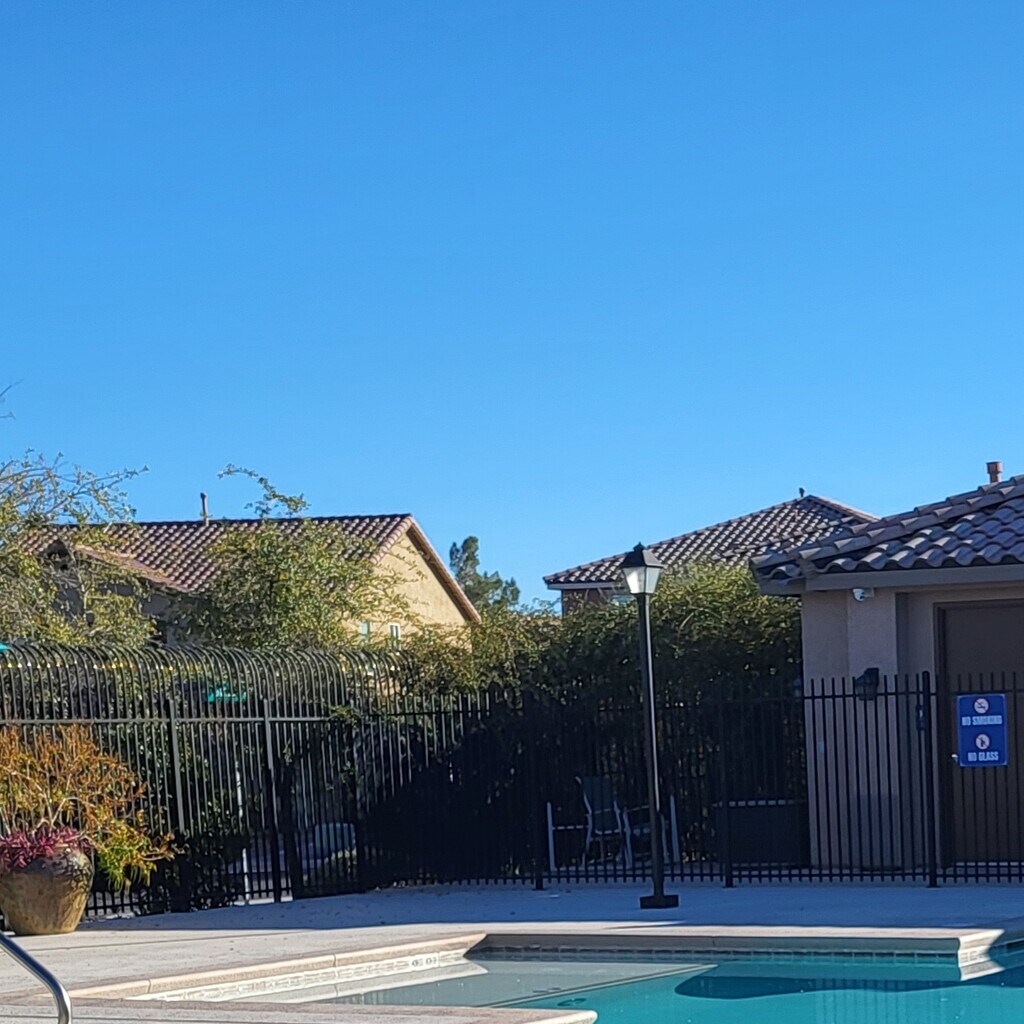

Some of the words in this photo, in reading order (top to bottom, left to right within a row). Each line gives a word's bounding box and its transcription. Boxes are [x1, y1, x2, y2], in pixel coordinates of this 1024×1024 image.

[962, 716, 971, 726] NO
[968, 752, 977, 761] NO
[978, 751, 999, 761] GLASS
